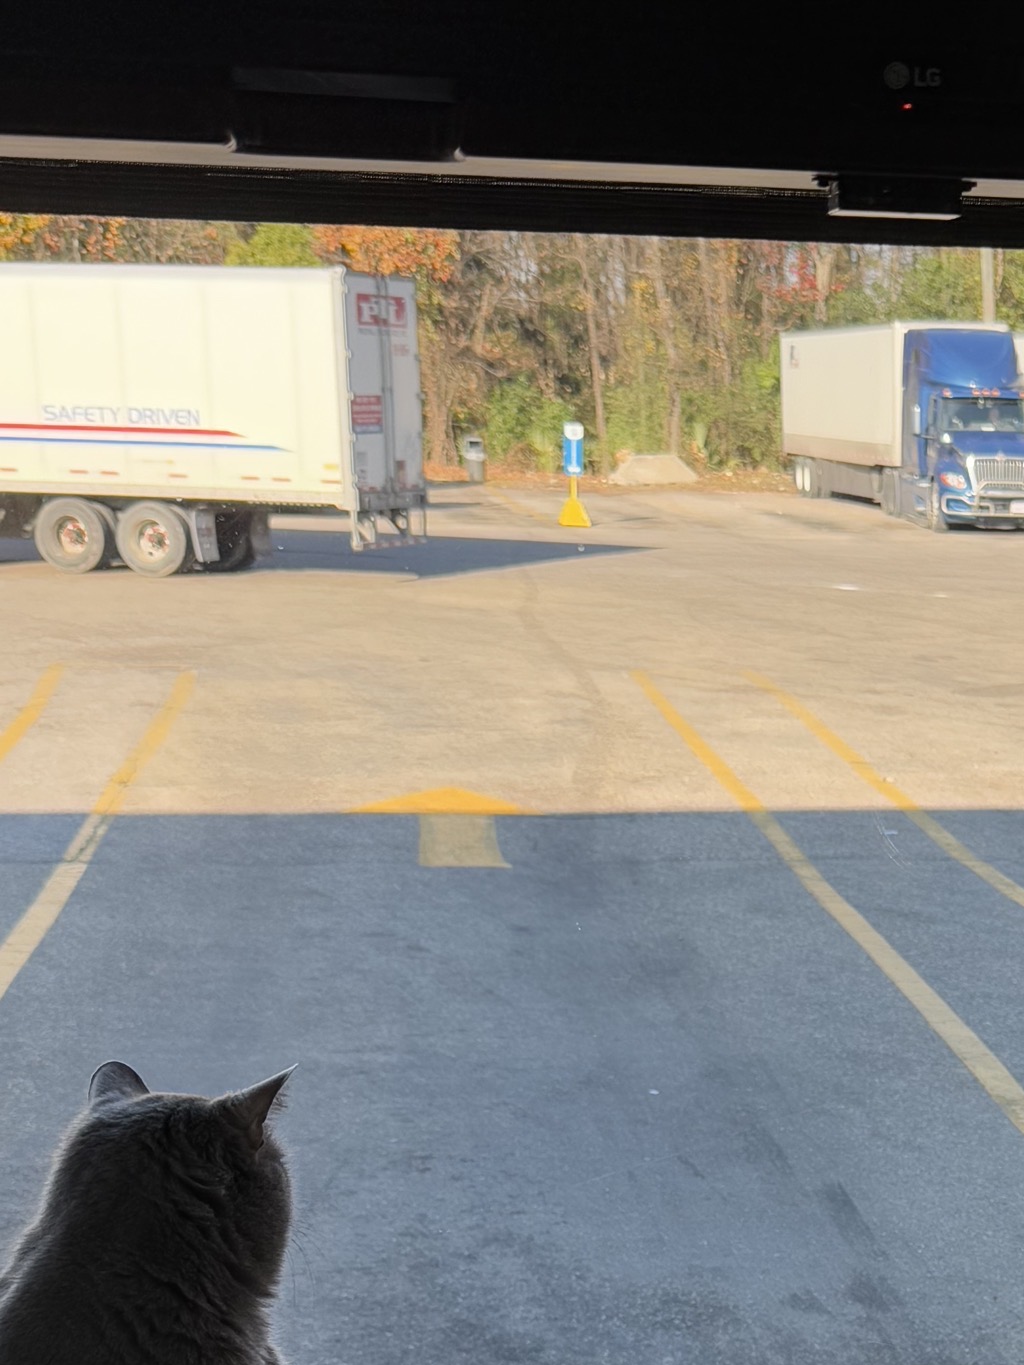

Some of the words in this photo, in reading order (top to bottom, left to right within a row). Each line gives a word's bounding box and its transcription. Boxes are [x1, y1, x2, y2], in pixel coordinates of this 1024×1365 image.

[913, 66, 942, 88] LG
[42, 405, 120, 423] SAFETY
[127, 407, 201, 426] DRIVEN
